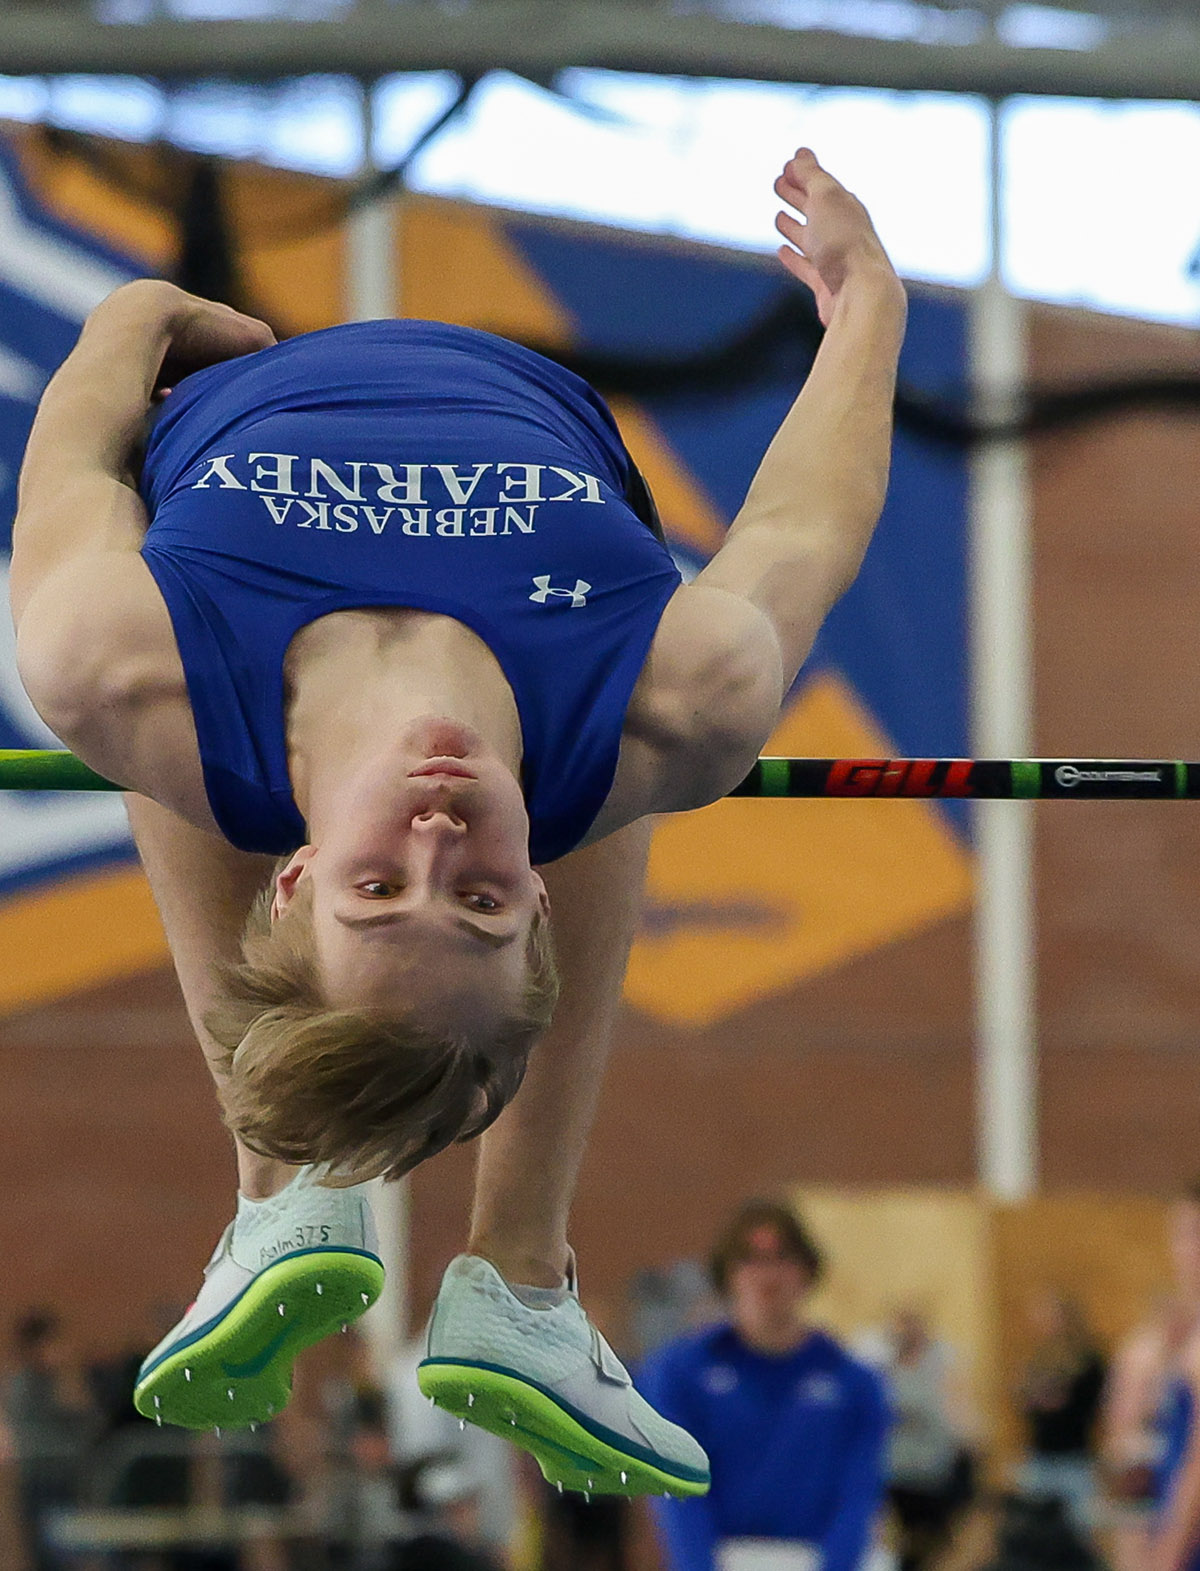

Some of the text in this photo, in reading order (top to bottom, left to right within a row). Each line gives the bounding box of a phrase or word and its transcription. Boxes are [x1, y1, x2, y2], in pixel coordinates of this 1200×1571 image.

[191, 452, 606, 505] KEARNEY
[258, 495, 538, 538] NEBRASKA
[825, 759, 975, 797] GILL
